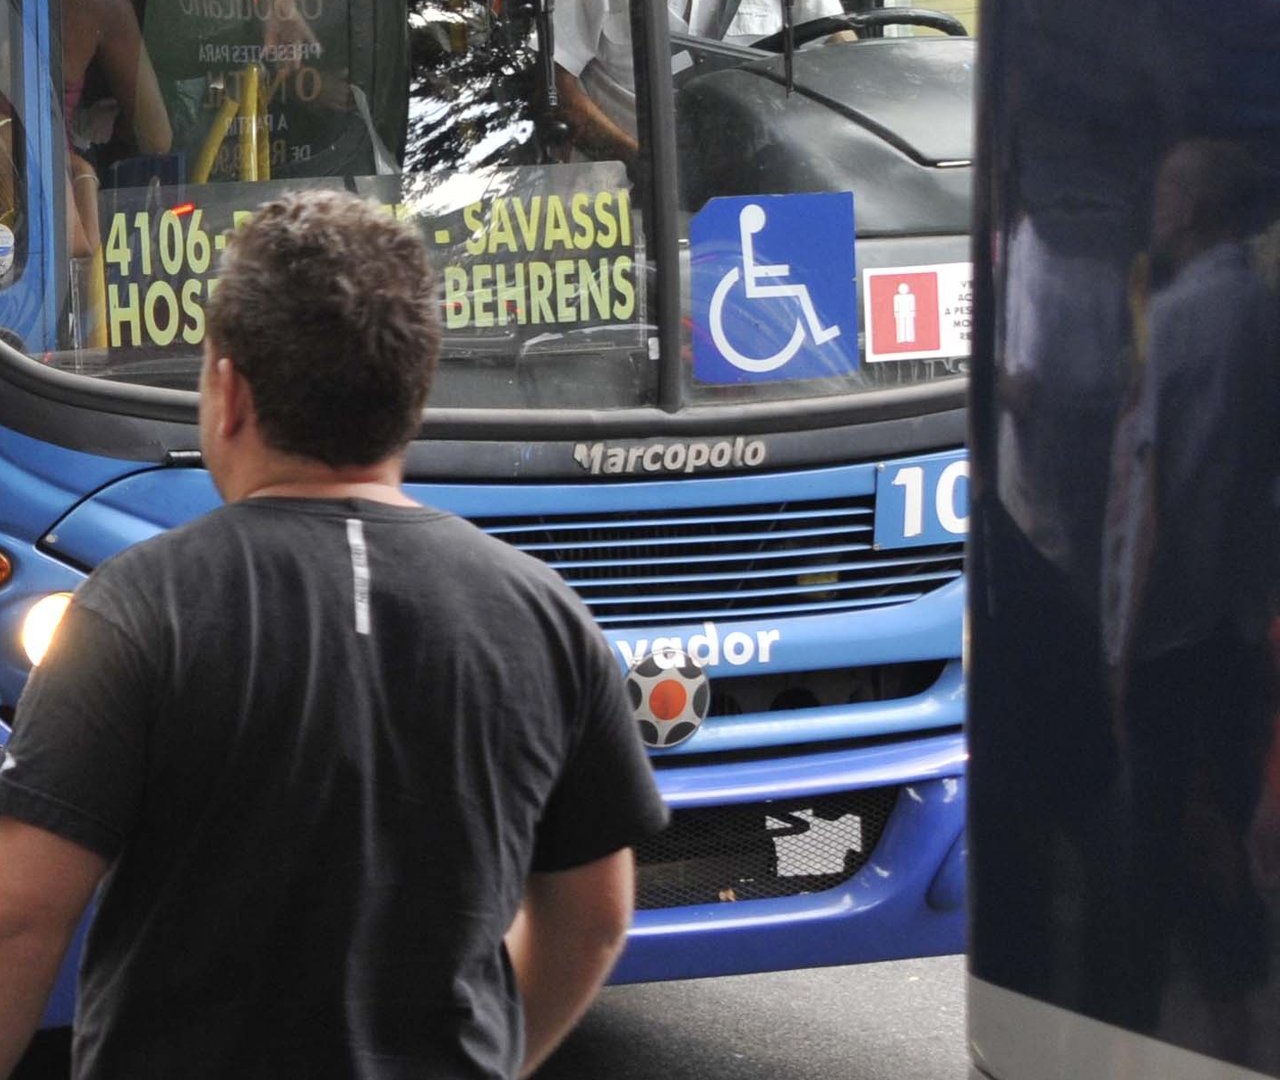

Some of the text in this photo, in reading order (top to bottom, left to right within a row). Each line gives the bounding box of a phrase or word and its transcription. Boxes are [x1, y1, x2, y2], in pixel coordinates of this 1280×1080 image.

[463, 189, 632, 255] SAVASSI
[443, 256, 636, 330] BEHRENS
[573, 436, 767, 475] Marcopolo
[615, 621, 780, 670] vador
